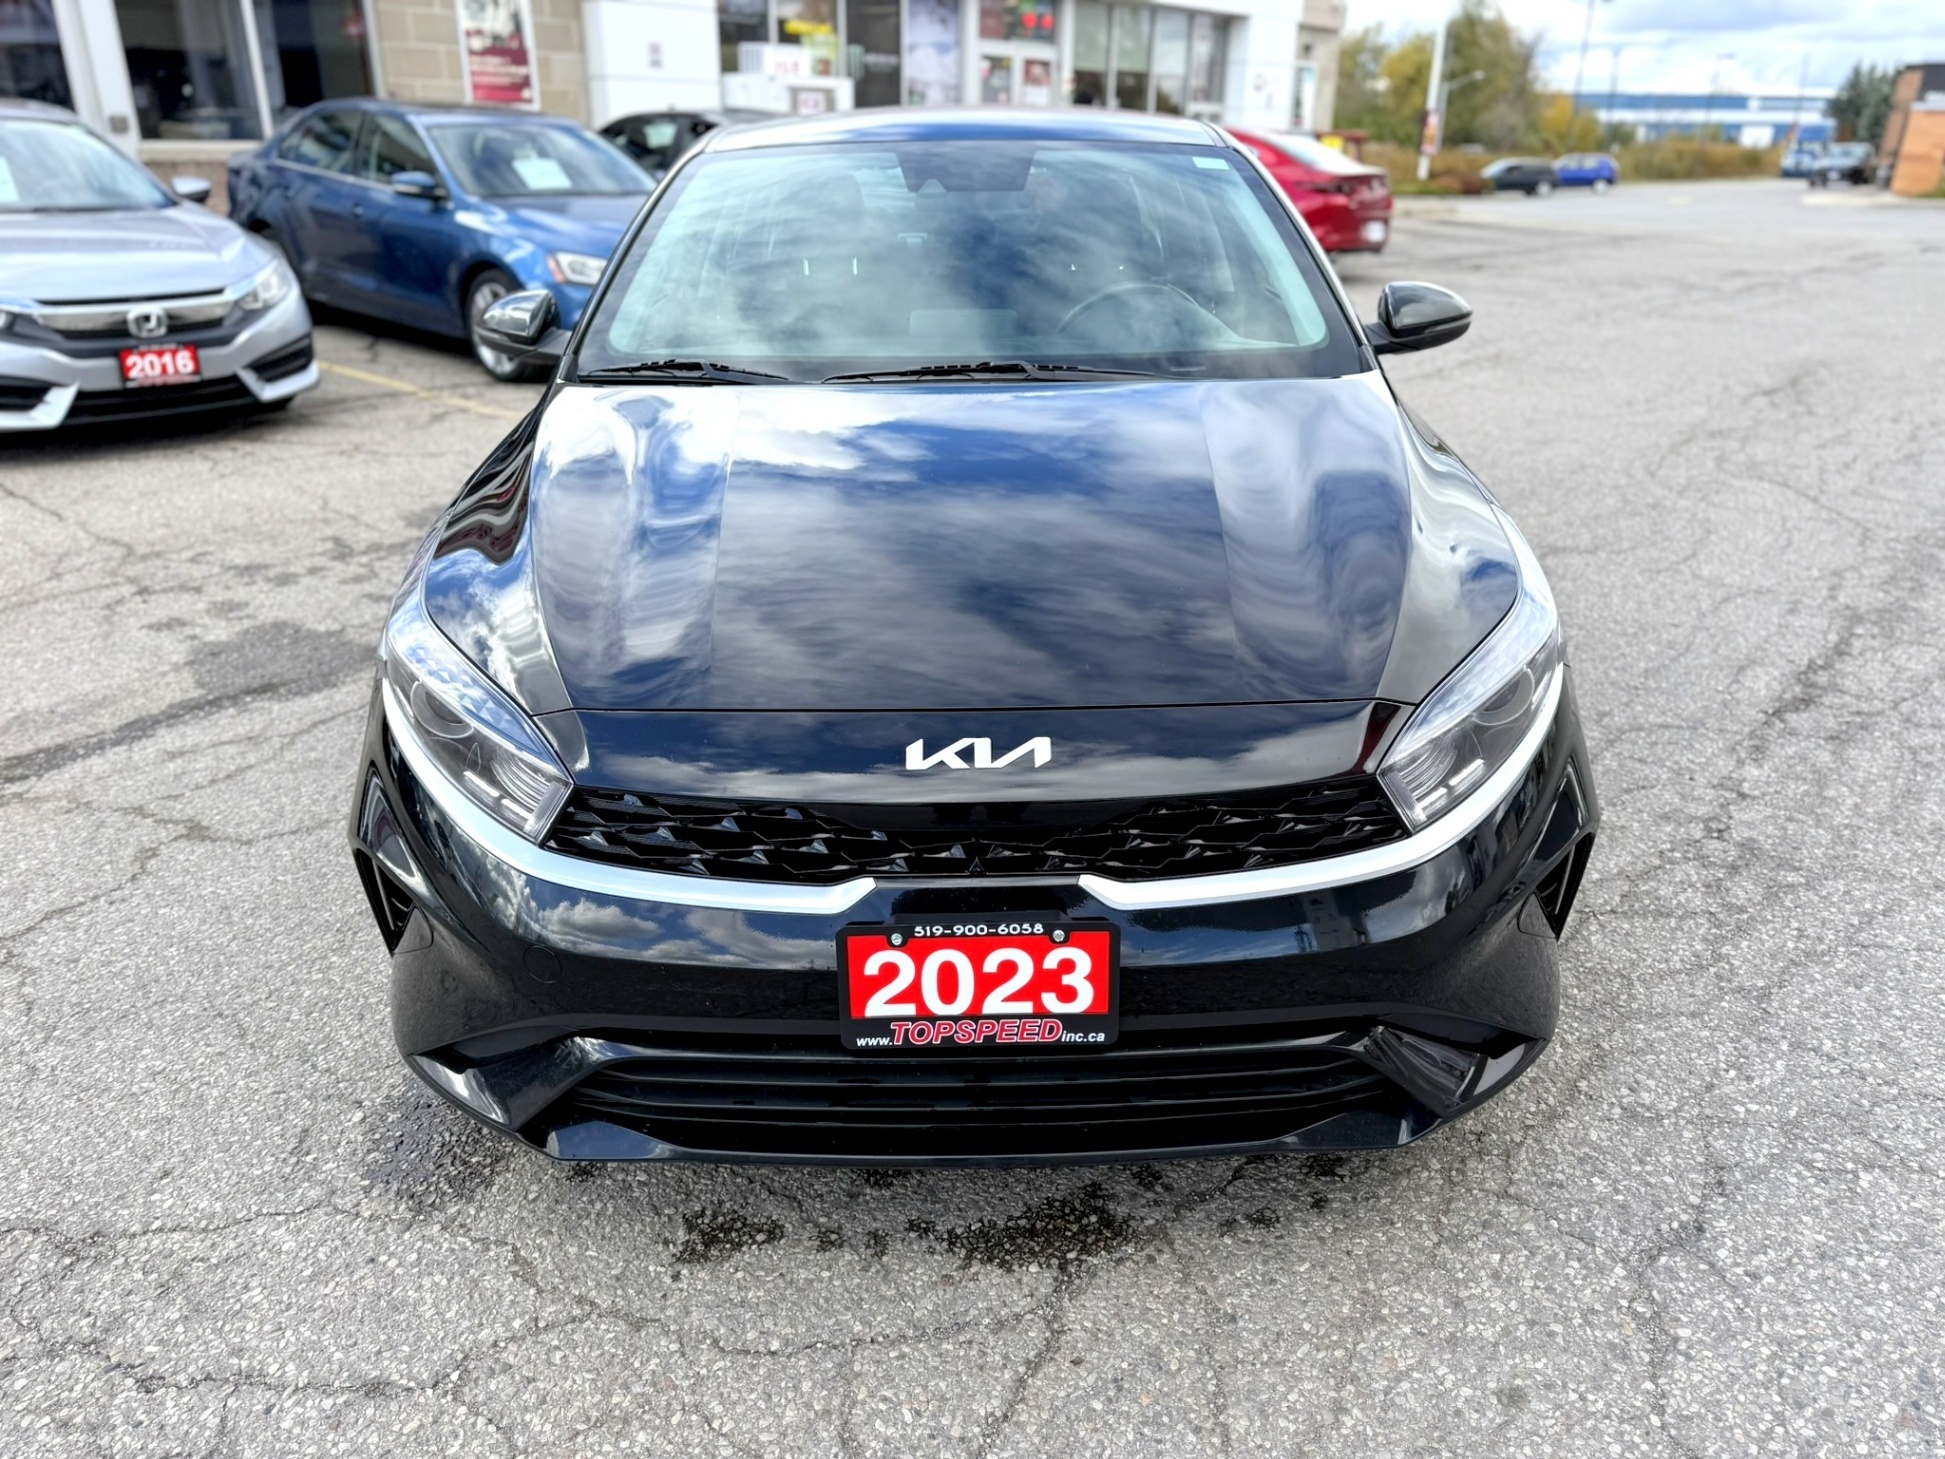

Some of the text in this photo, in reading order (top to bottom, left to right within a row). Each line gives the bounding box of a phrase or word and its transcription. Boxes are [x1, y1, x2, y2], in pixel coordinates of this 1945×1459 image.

[125, 350, 195, 379] 2016
[905, 736, 1052, 770] KIA
[914, 923, 1045, 937] 519-900-6058
[864, 947, 1094, 1018] 2023
